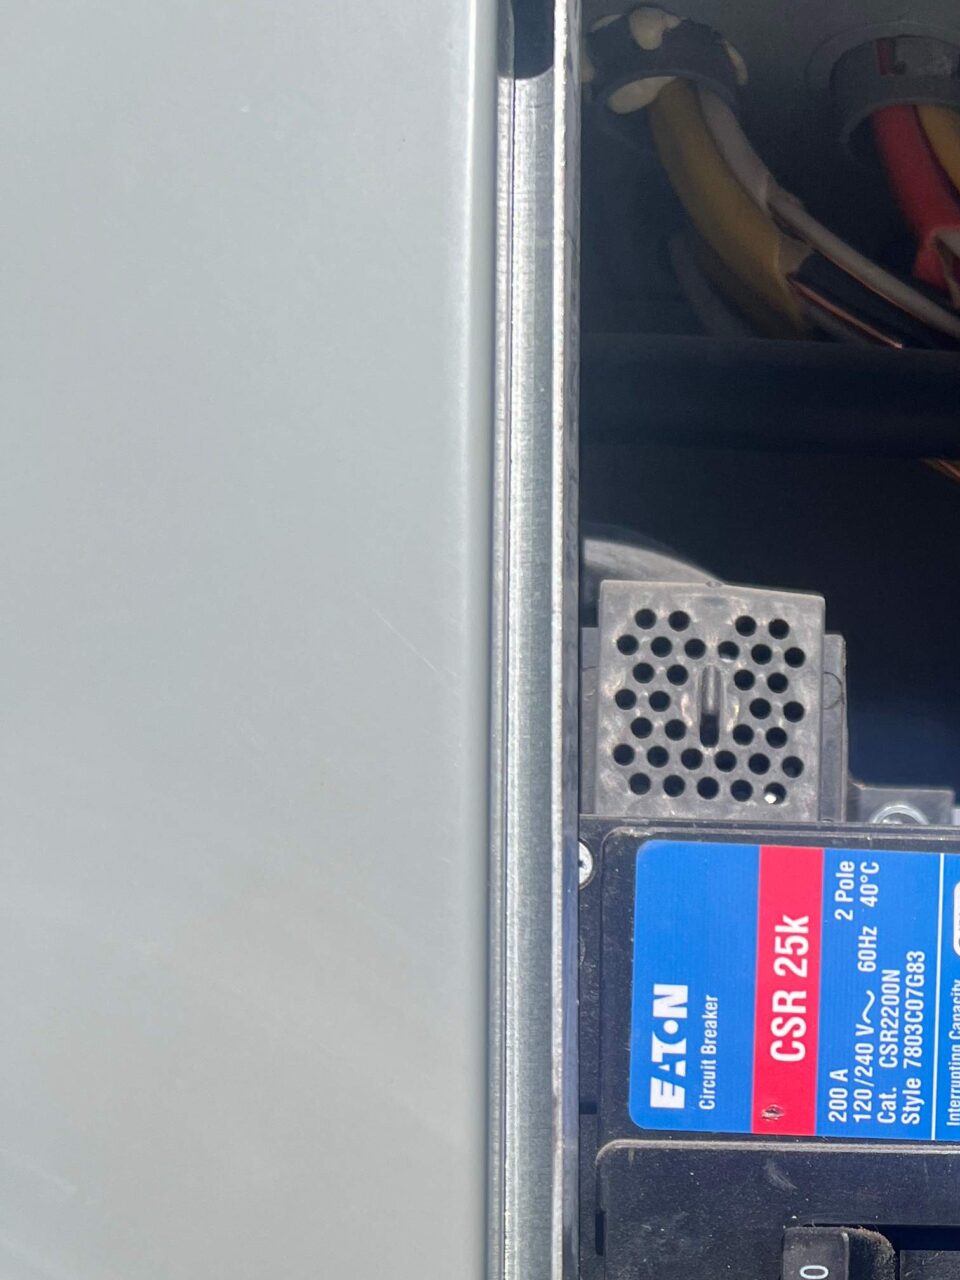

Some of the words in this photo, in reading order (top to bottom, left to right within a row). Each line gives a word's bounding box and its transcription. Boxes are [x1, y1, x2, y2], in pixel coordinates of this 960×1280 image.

[835, 861, 854, 902] Pole
[860, 862, 879, 907] 40°C
[835, 909, 853, 920] 2
[774, 915, 808, 977] 25k
[858, 926, 877, 972] 60Hz
[701, 995, 717, 1054] Breaker
[771, 991, 806, 1061] CSR
[879, 970, 900, 1068] CSR2200N
[903, 951, 925, 1068] 7803C07G83
[650, 984, 688, 1108] EATON
[699, 1060, 716, 1110] Circuit
[830, 1069, 848, 1082] A
[853, 1043, 874, 1122] 120/240
[828, 1088, 848, 1122] 200
[877, 1088, 896, 1123] Cat.
[901, 1078, 924, 1124] Style
